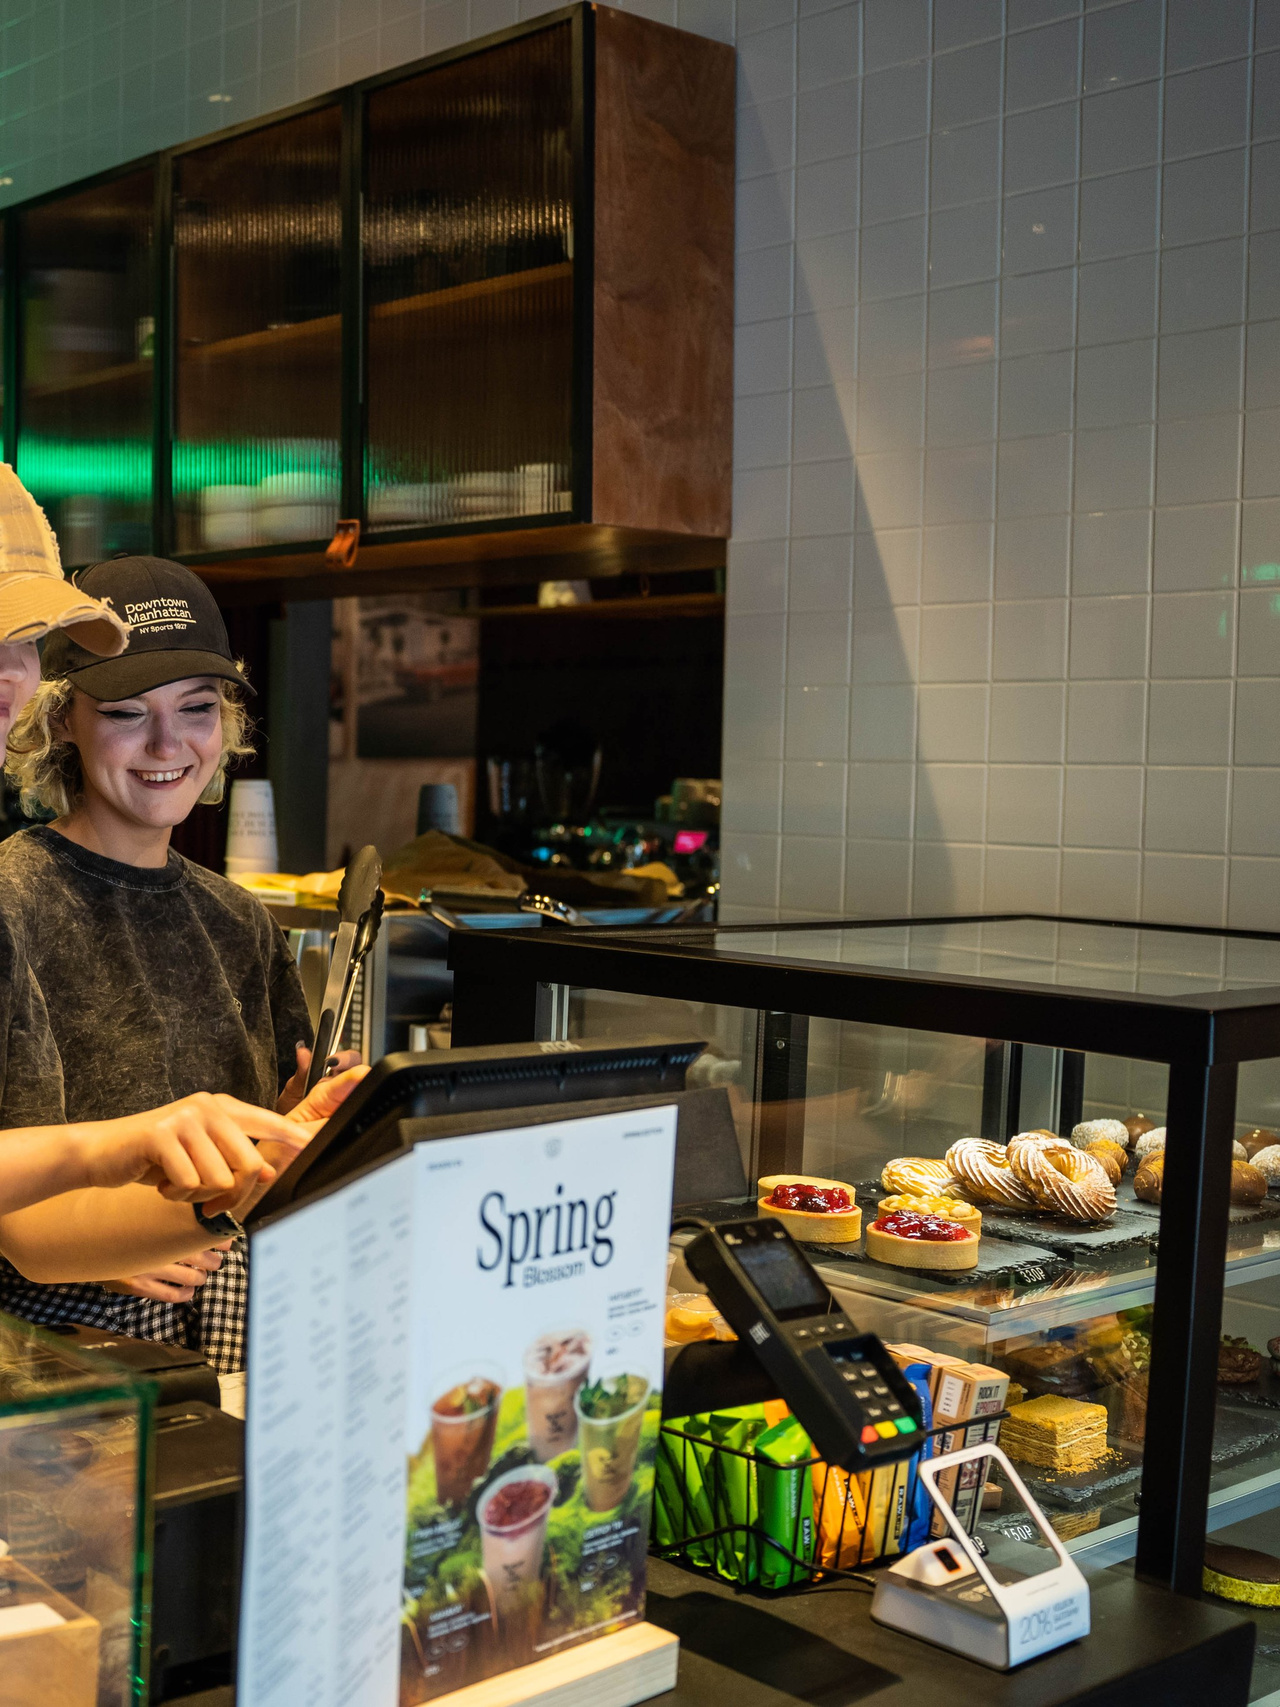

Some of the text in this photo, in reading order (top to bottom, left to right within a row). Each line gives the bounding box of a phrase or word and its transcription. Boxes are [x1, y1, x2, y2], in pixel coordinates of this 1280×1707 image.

[125, 597, 188, 614] Downtown
[128, 607, 192, 624] Manhattan
[151, 624, 174, 632] Sports
[477, 1183, 618, 1288] Spring
[522, 1261, 586, 1289] Blossom
[1020, 1607, 1053, 1645] 20%
